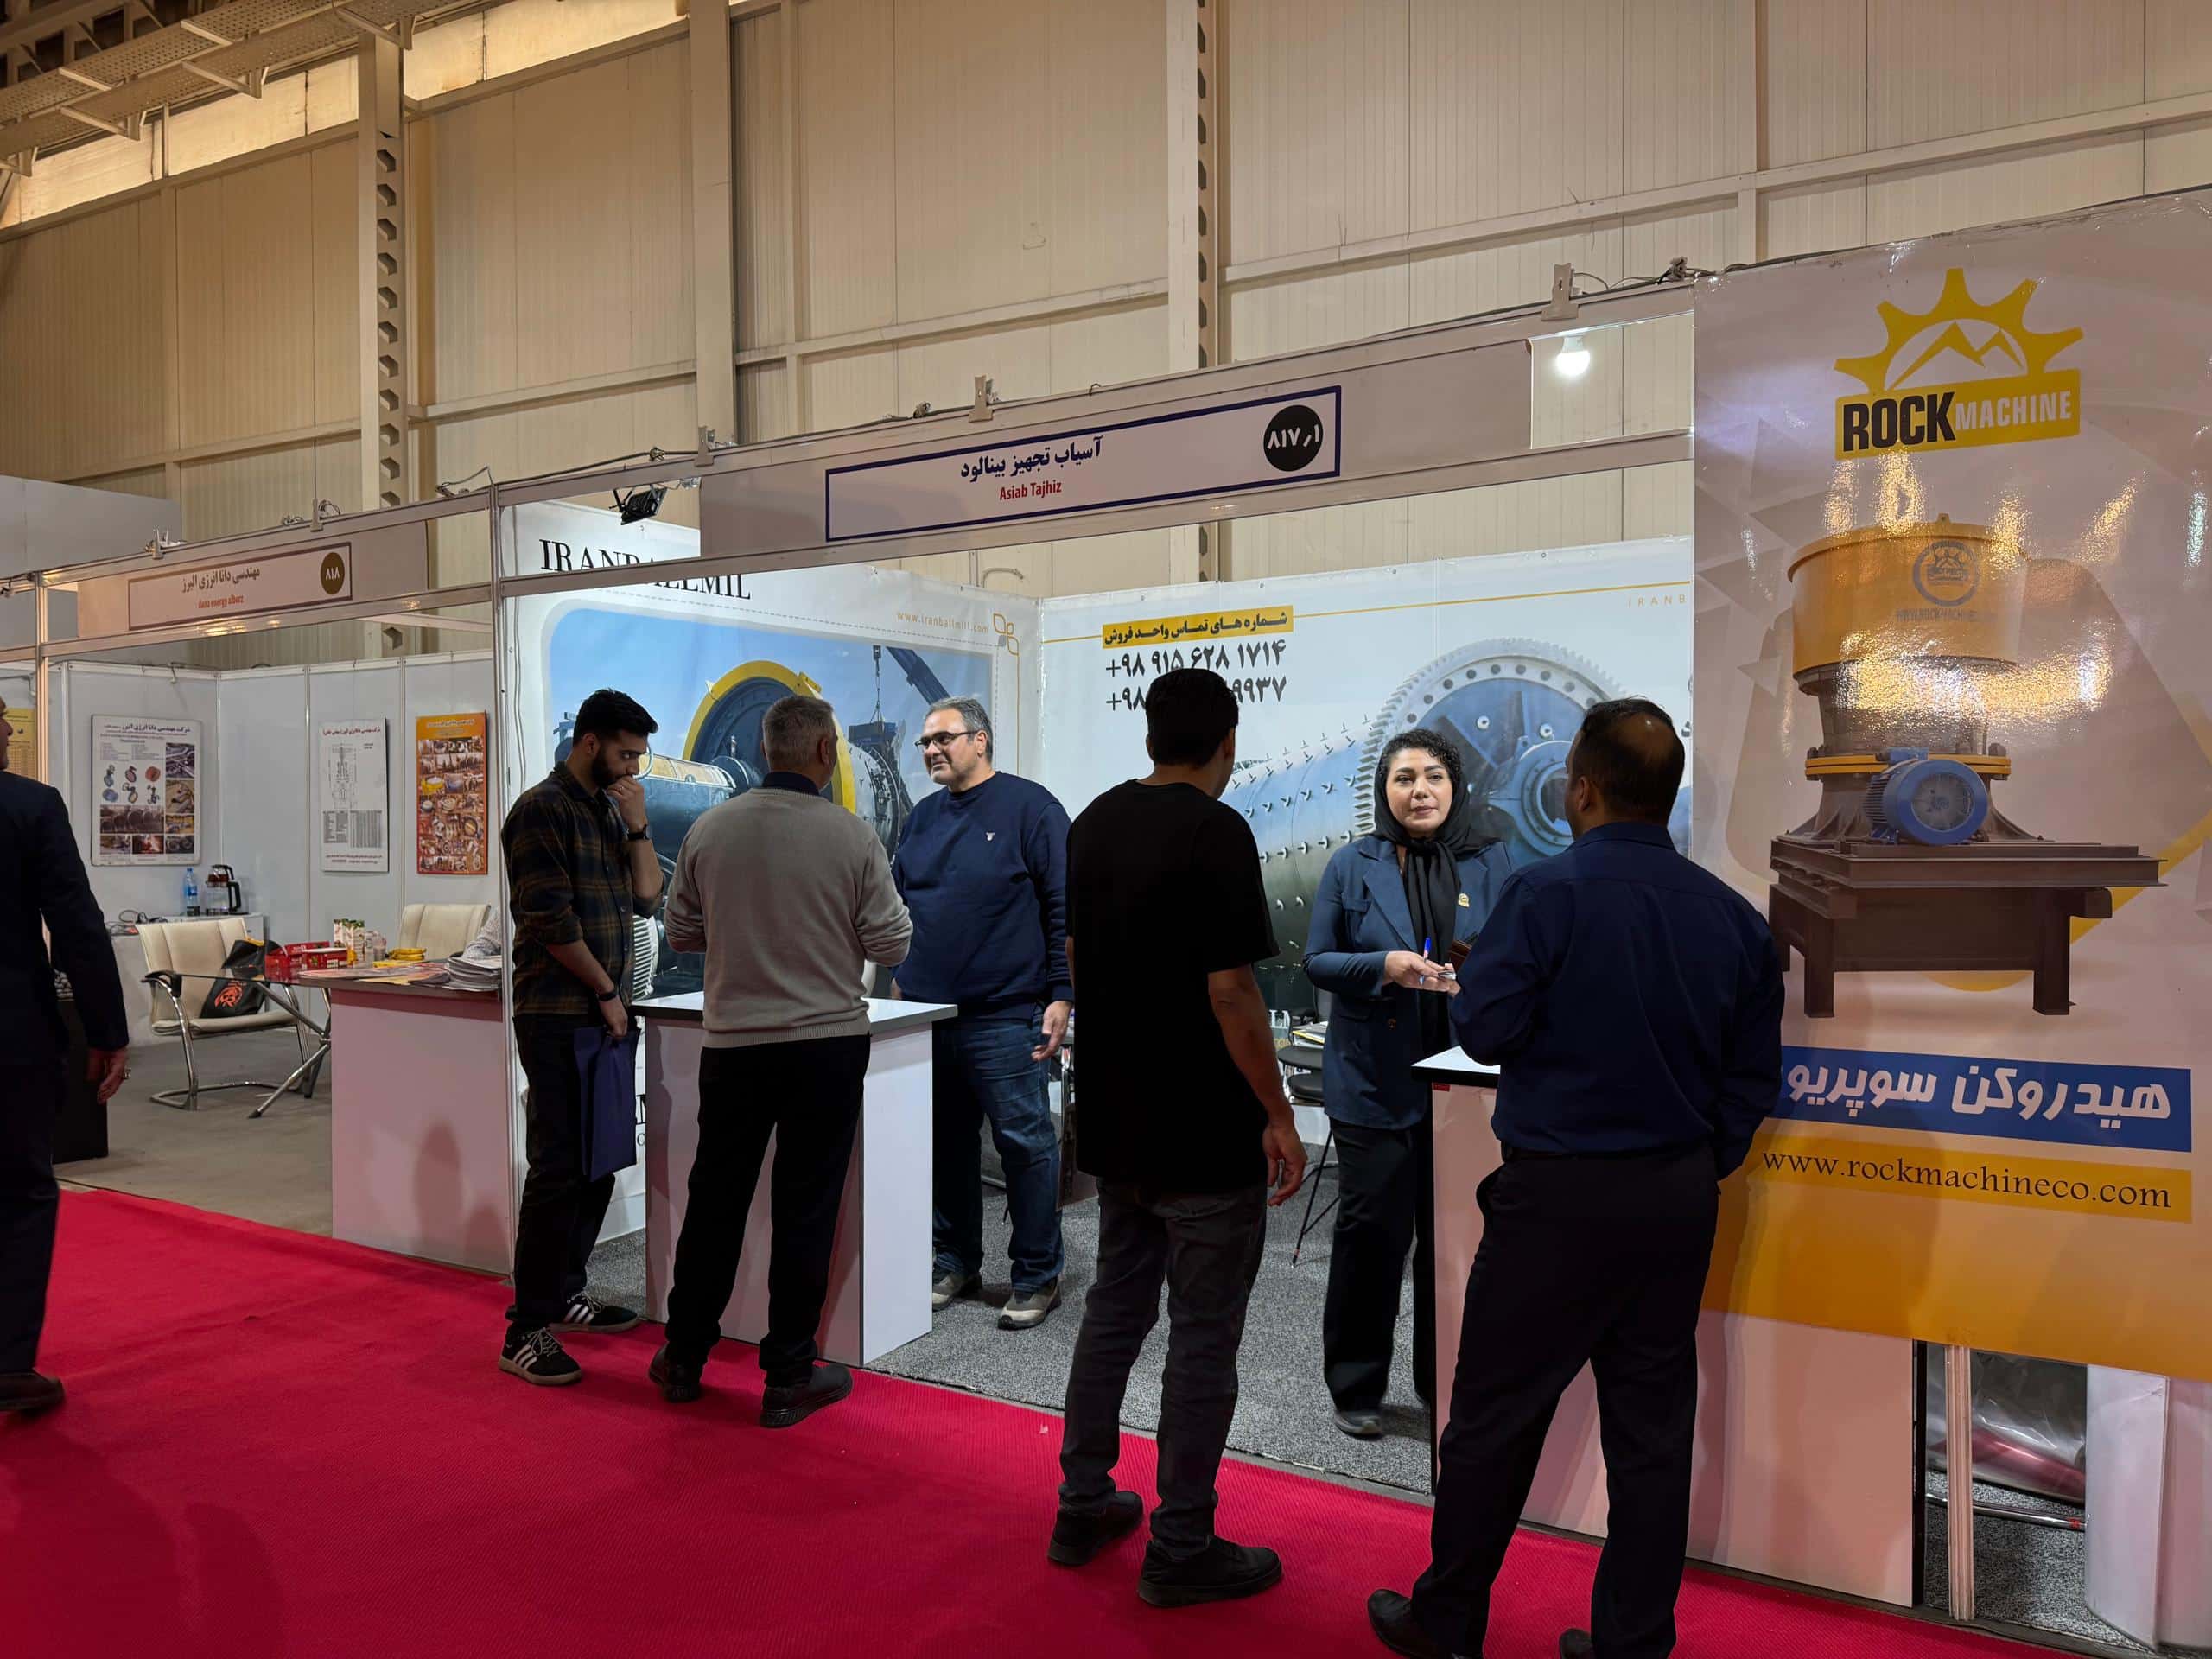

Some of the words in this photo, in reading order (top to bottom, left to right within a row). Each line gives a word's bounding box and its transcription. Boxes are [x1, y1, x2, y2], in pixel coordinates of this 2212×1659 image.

[1843, 391, 1955, 452] ROCK
[1955, 391, 2071, 430] MACHINE
[1010, 447, 1051, 476] تجهیز
[1054, 435, 1103, 468] آسیاب
[961, 454, 1006, 482] بینالود
[1000, 484, 1028, 501] Asiab
[1030, 480, 1062, 499] Tajhiz
[232, 567, 260, 584] مهندسی
[325, 566, 340, 581] ۸۱۸
[1135, 624, 1169, 639] واحد
[1171, 619, 1209, 638] تماس
[1210, 617, 1243, 634] های
[1244, 612, 1287, 632] شماره
[1104, 626, 1134, 645] فروش
[1787, 1065, 1937, 1118] سوپریو
[1951, 1065, 2171, 1129] هیدروکن
[1762, 1150, 2171, 1208] www.rockmachineco.com
